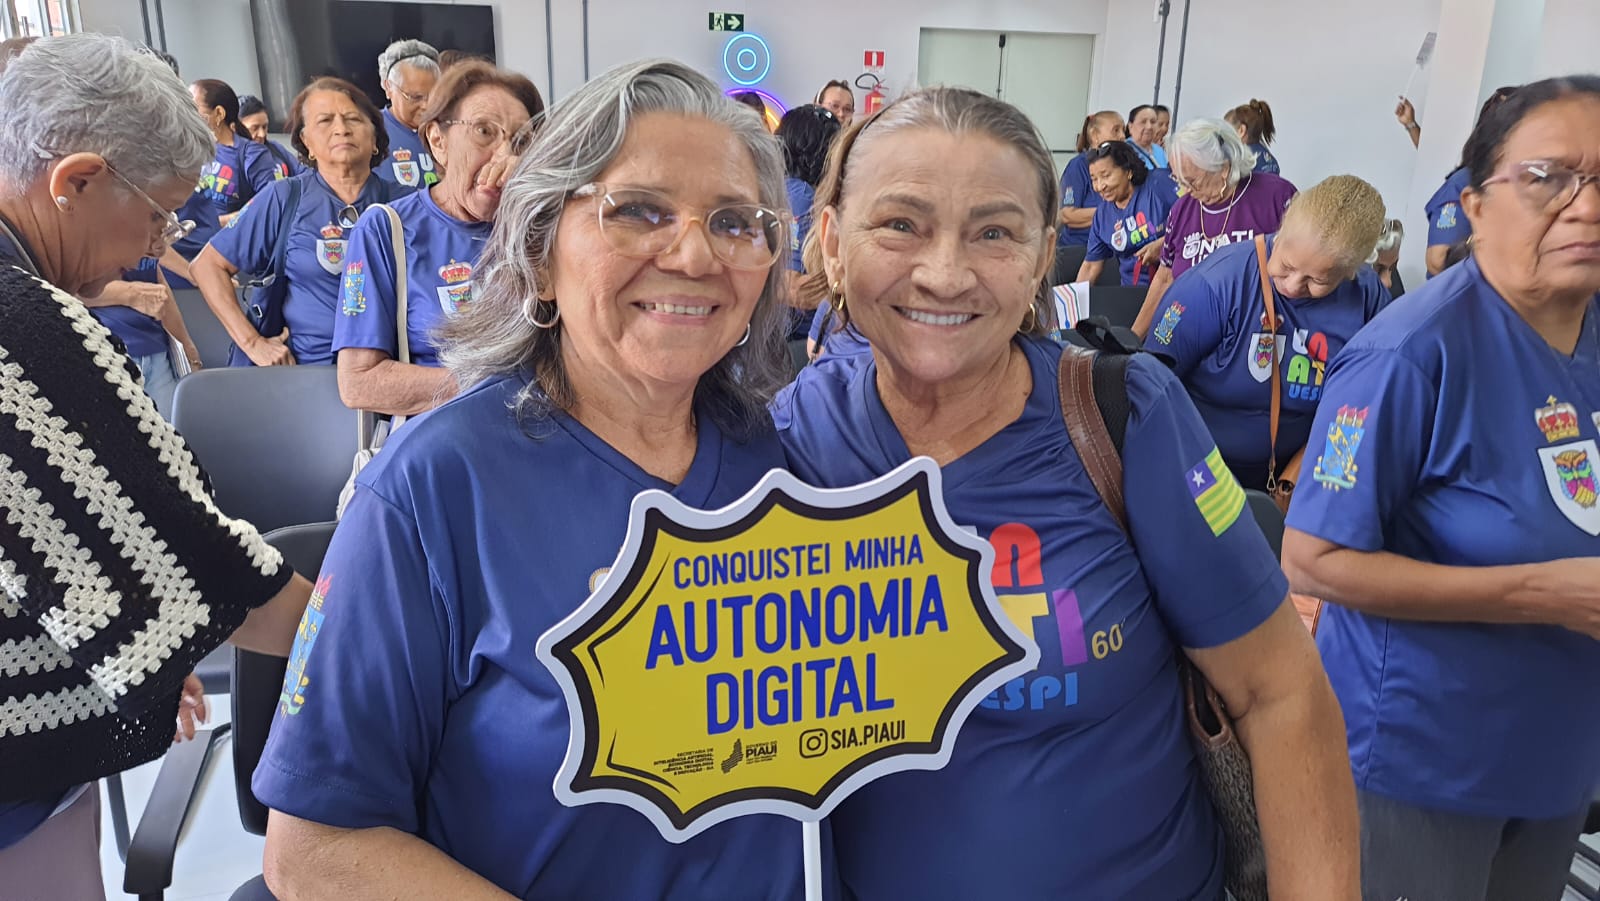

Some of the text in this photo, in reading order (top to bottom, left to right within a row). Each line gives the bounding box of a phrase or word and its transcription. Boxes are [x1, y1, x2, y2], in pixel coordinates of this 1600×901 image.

[1287, 354, 1325, 387] AT
[1288, 384, 1319, 401] UES
[674, 534, 924, 590] CONQUISTEI MINHA
[645, 574, 949, 670] AUTONOMIA
[706, 652, 895, 735] DIGITAL
[830, 719, 906, 750] SIA.PIAUI
